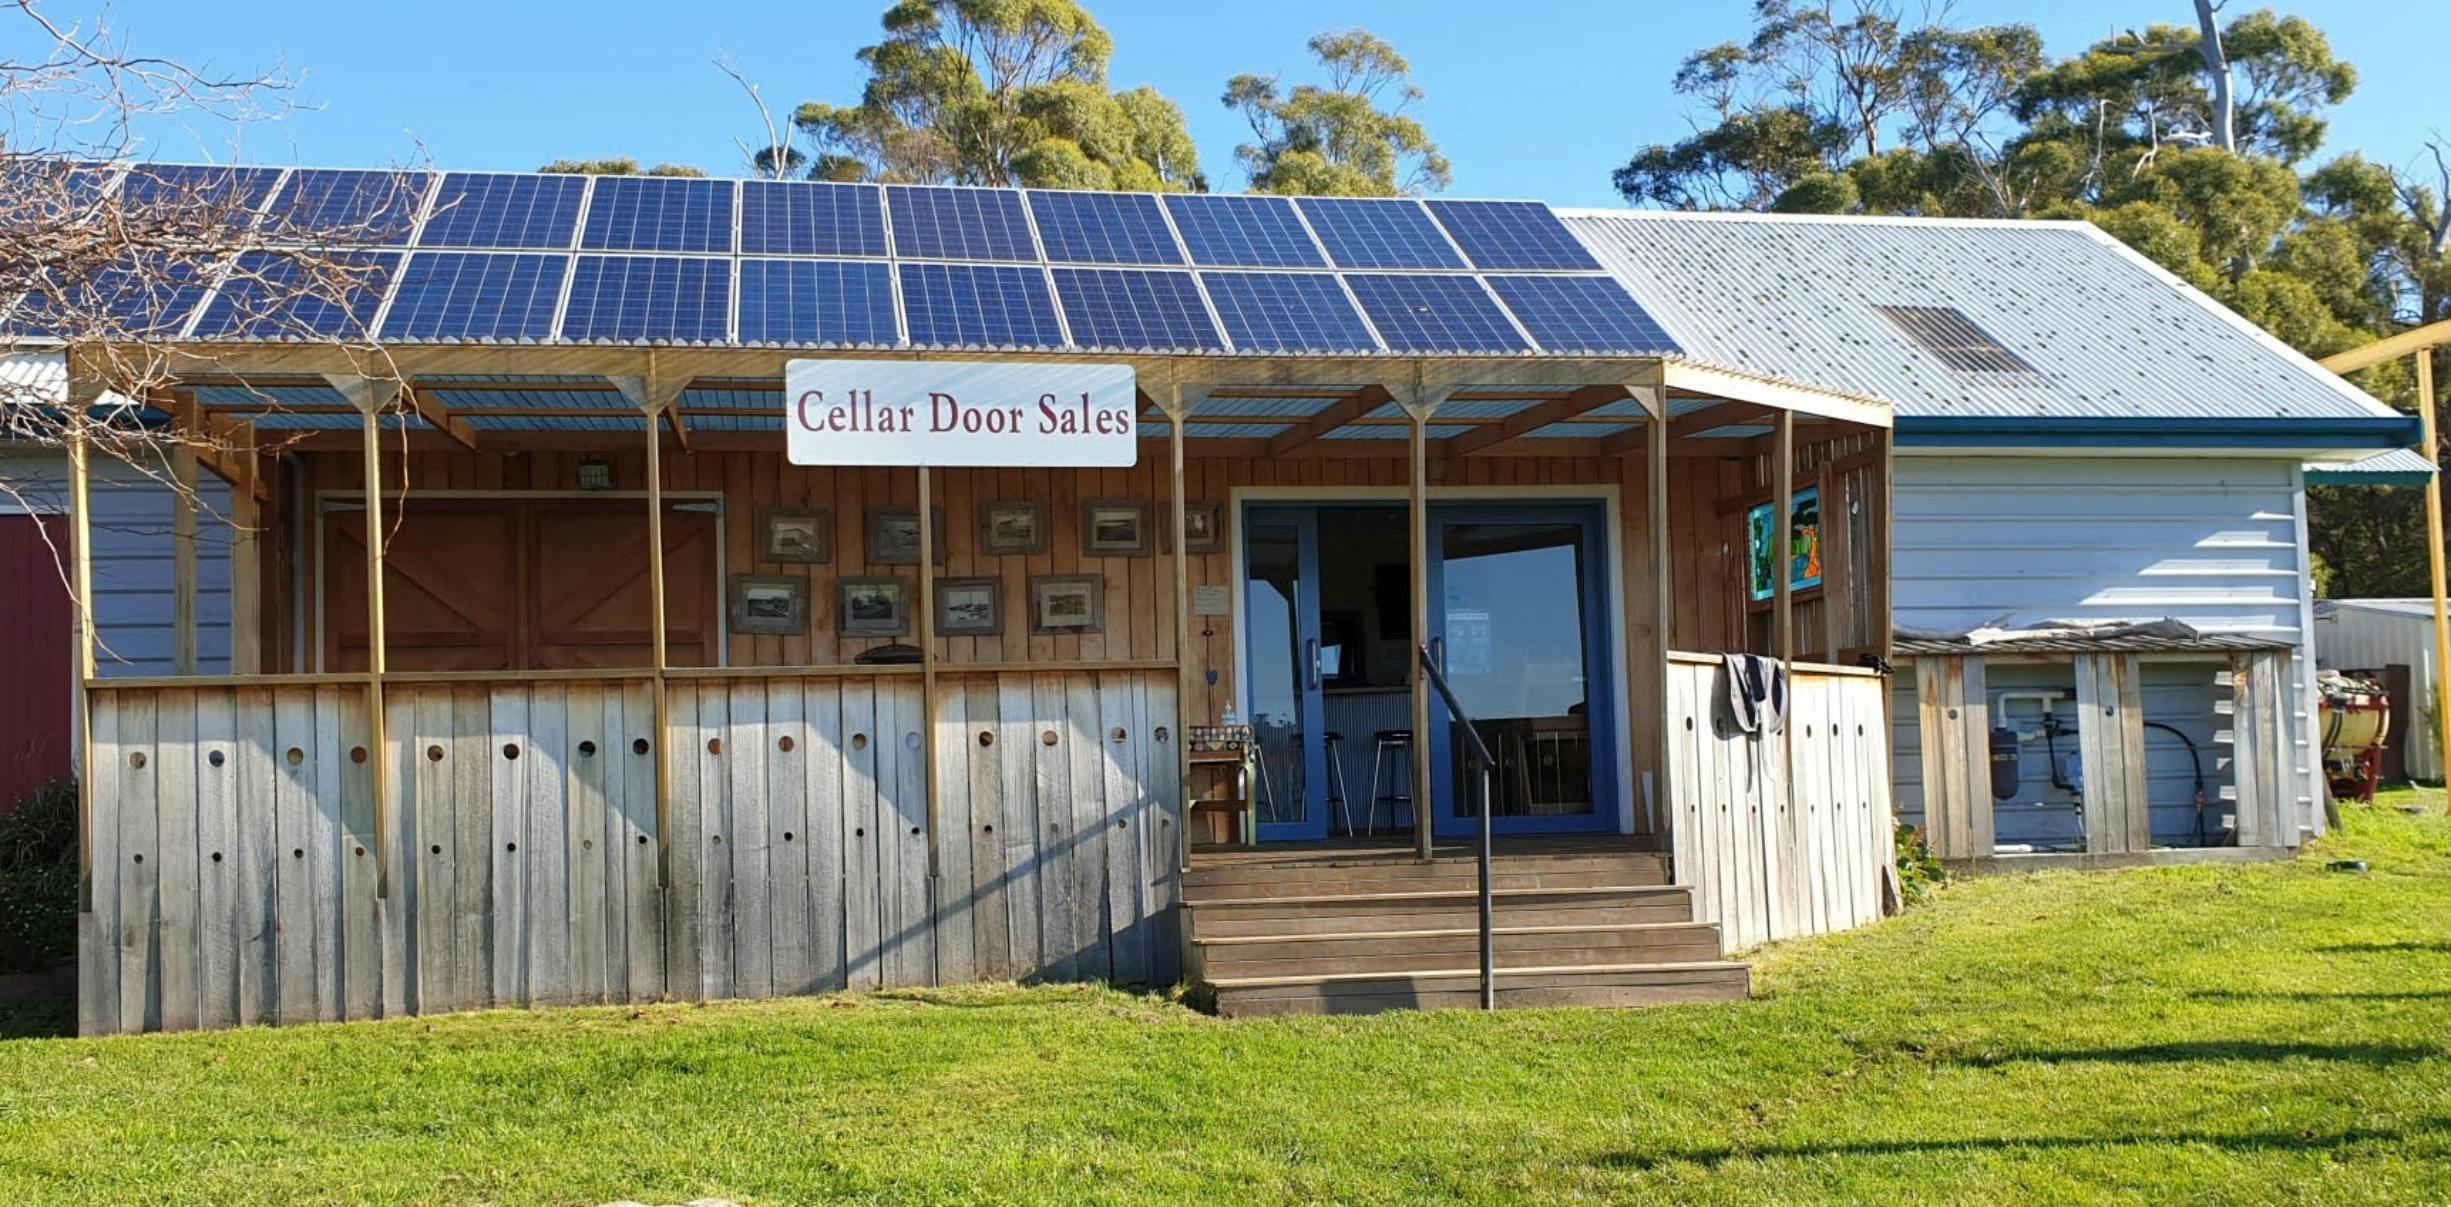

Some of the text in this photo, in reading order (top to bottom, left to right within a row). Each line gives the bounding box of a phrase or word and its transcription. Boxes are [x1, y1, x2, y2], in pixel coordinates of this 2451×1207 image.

[797, 389, 1130, 435] Cellar Door Sales
